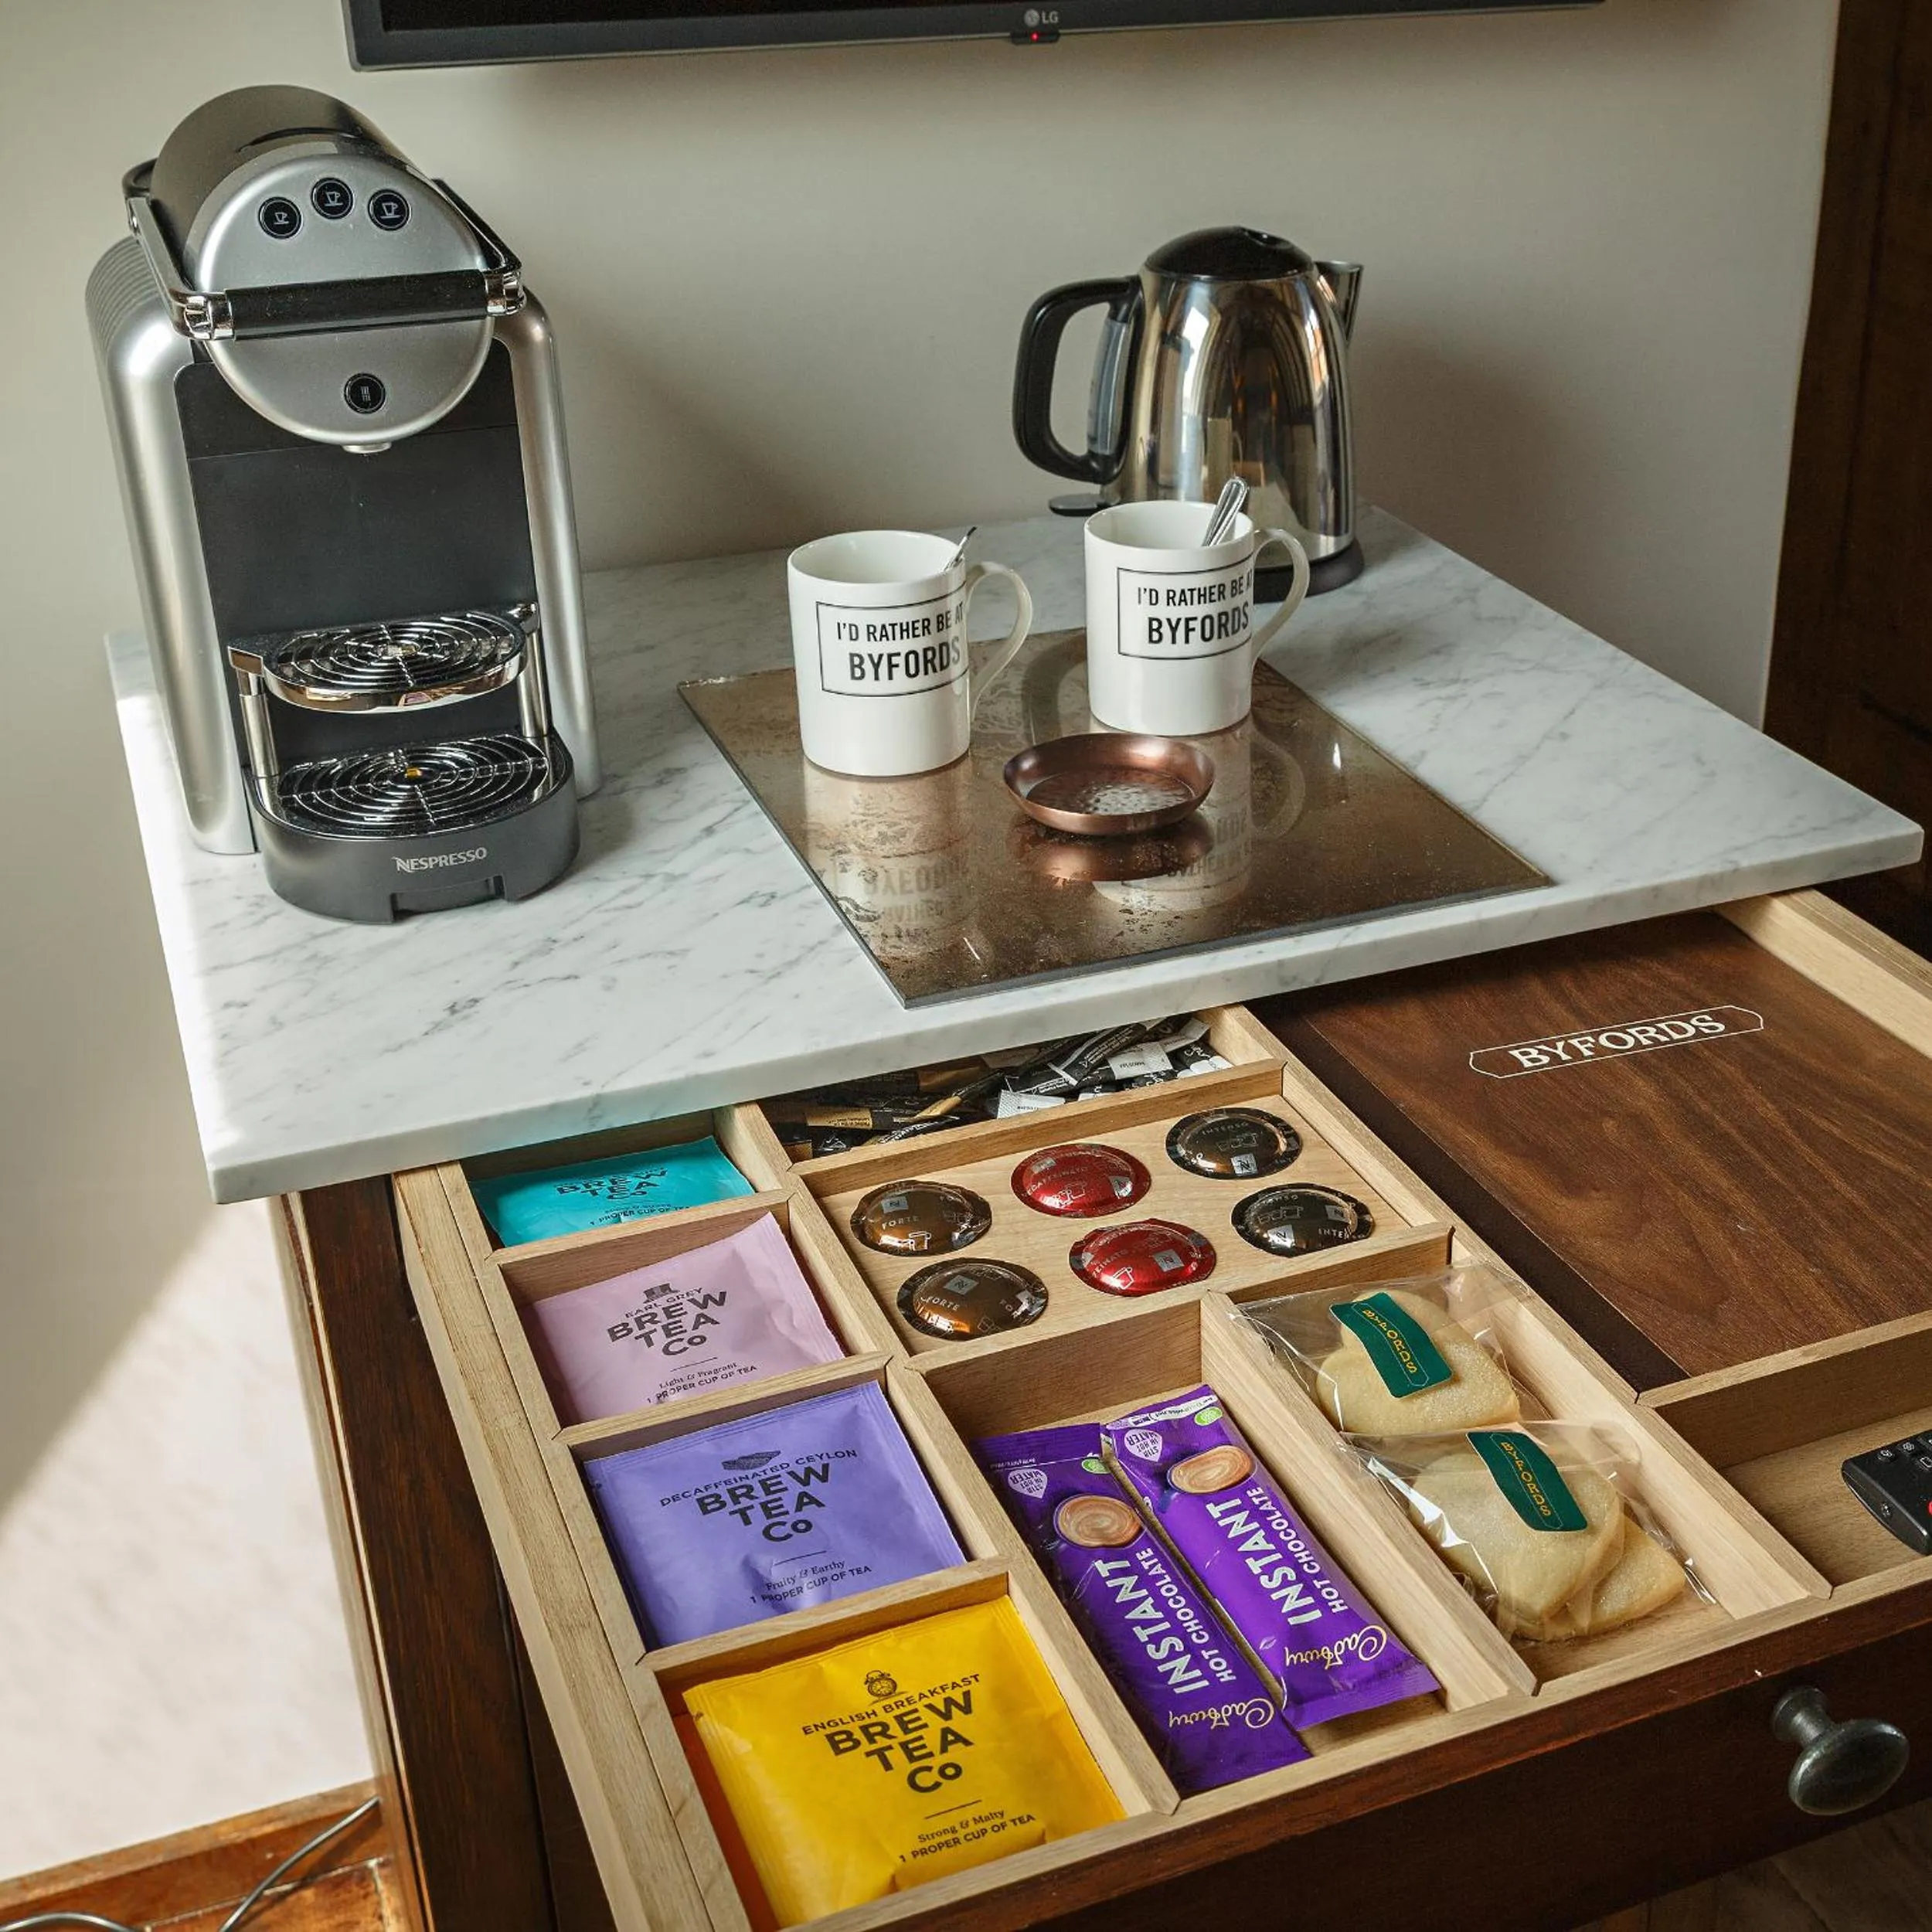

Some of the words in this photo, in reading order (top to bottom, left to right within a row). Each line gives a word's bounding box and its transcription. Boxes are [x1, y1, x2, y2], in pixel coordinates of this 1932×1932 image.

[1042, 11, 1060, 24] LG
[1138, 587, 1158, 607] I'D
[1166, 583, 1226, 607] RATHER
[1230, 576, 1244, 598] BE
[837, 621, 859, 641] I'D
[866, 617, 931, 642] RATHER
[937, 609, 951, 632] BE
[954, 600, 964, 626] AT
[1148, 601, 1250, 645] BYFORDS
[849, 636, 961, 682] BYFORDS
[391, 847, 488, 872] NESPRESSO
[1509, 1014, 1726, 1069] BYFORDS
[581, 1181, 660, 1197] TEA
[882, 1215, 920, 1230] FORTE
[607, 1291, 727, 1342] BREW
[625, 1302, 662, 1318] EARL
[666, 1287, 703, 1304] GREY
[634, 1313, 720, 1348] TEA
[662, 1335, 707, 1355] Co
[1362, 1308, 1417, 1373] BYFORDS
[656, 1383, 696, 1400] PROPER
[698, 1376, 718, 1386] CUP
[720, 1371, 735, 1379] OF
[736, 1365, 757, 1376] TEA
[659, 1376, 684, 1389] Light
[698, 1362, 737, 1379] Fragrant
[1126, 1432, 1159, 1446] WATER
[1144, 1447, 1159, 1458] STIR
[660, 1462, 790, 1507] DECAFFEINATED
[795, 1449, 858, 1465] CEYLON
[696, 1463, 830, 1515] BREW
[1009, 1471, 1043, 1485] WATER
[1500, 1441, 1552, 1516] BYFORDS
[729, 1491, 825, 1526] TEA
[762, 1519, 813, 1542] Co
[1246, 1486, 1321, 1574] CHOCOLATE
[765, 1573, 797, 1590] Fruity
[811, 1560, 845, 1577] Earthy
[1206, 1498, 1322, 1625] INSTANT
[761, 1585, 804, 1603] PROPER
[806, 1577, 828, 1590] CUP
[831, 1572, 846, 1583] OF
[849, 1565, 872, 1577] TEA
[1135, 1548, 1209, 1645] CHOCOLATE
[1313, 1580, 1349, 1613] HOT
[1094, 1559, 1209, 1694] INSTANT
[1285, 1625, 1387, 1670] Cadbury
[1201, 1649, 1236, 1682] HOT
[801, 1709, 878, 1736] ENGLISH
[882, 1673, 981, 1714] BREAKFAST
[1168, 1698, 1275, 1730] Cadbury
[824, 1689, 974, 1757] BREW
[864, 1726, 975, 1772] TEA
[906, 1762, 963, 1794] Co
[899, 1854, 906, 1863] 1
[910, 1837, 962, 1859] PROPER
[964, 1828, 988, 1842] CUP
[990, 1821, 1009, 1834] OF
[1009, 1813, 1036, 1828] TEA
[918, 1824, 958, 1843] Strong
[960, 1819, 970, 1830] &
[973, 1809, 1005, 1825] Malty
